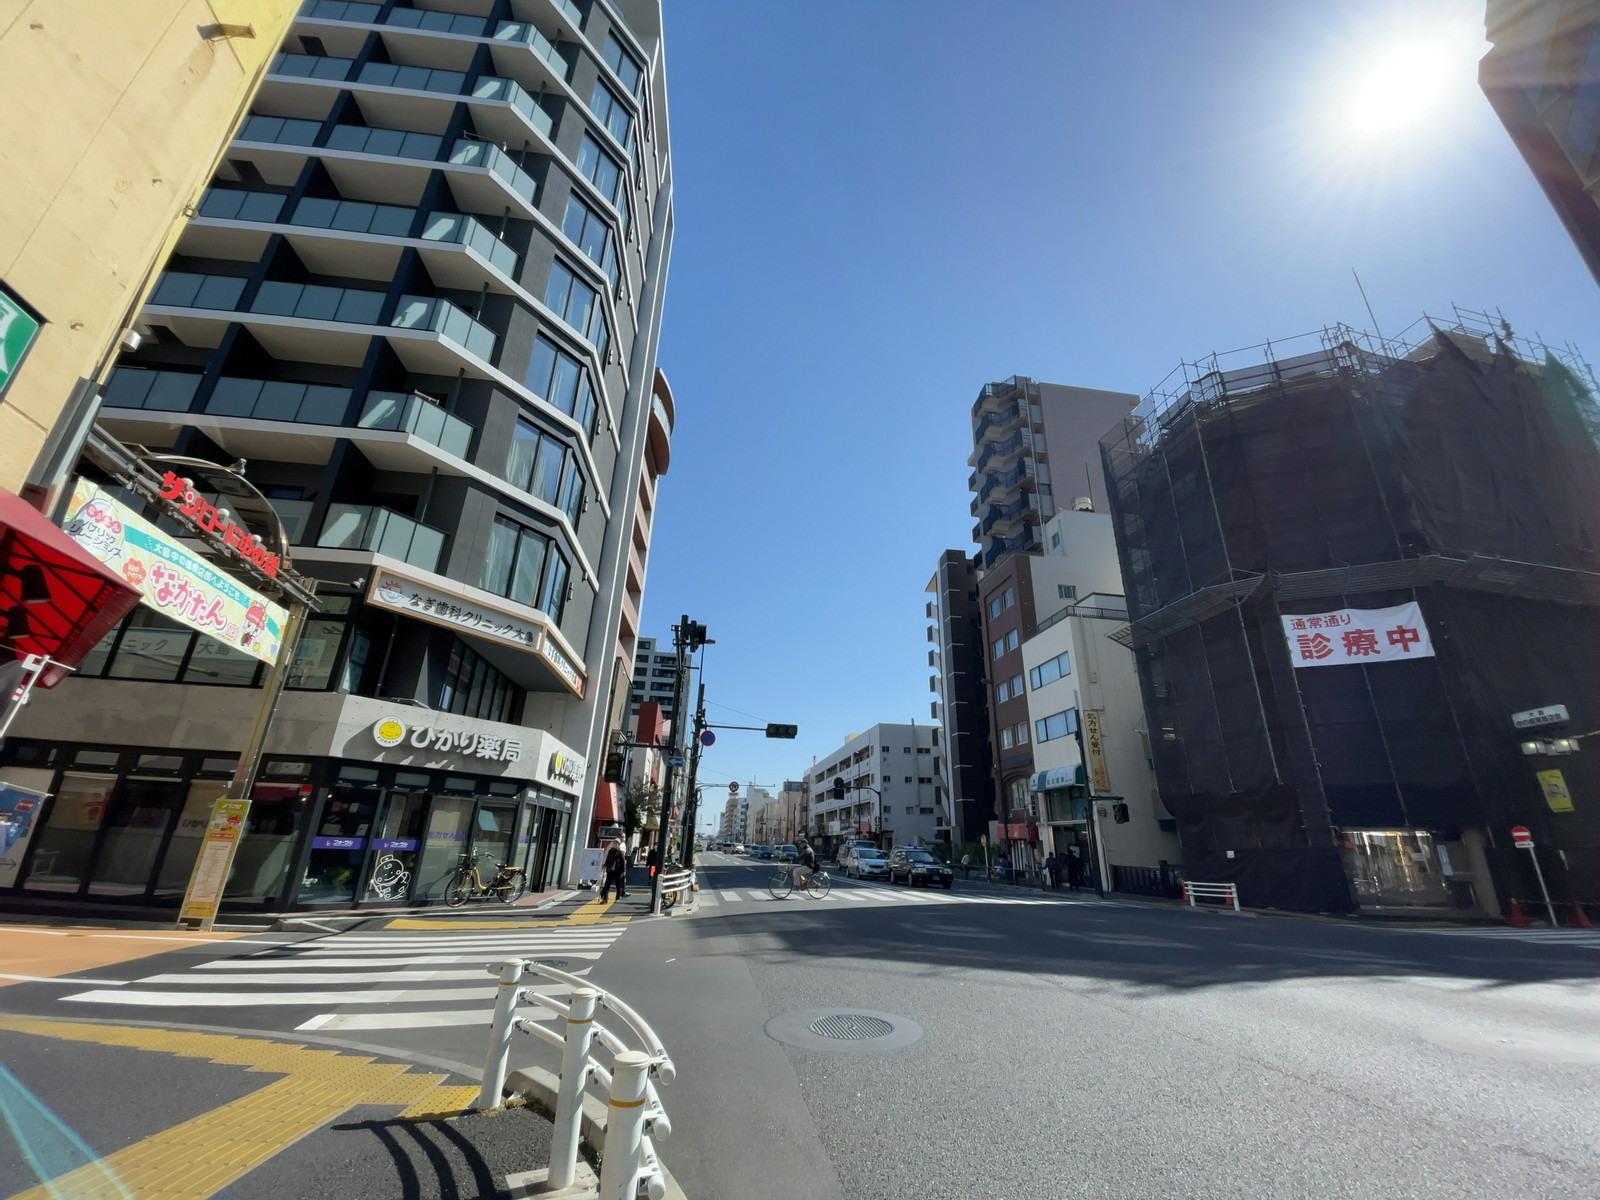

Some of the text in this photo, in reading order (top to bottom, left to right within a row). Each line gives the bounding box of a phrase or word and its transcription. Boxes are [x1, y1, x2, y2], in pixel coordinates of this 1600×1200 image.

[151, 562, 227, 629] なかたん
[1290, 613, 1351, 631] 通常通り
[1297, 625, 1421, 660] 診療中
[410, 725, 522, 763] ひかり薬局
[1086, 712, 1101, 756] 処方せん受付
